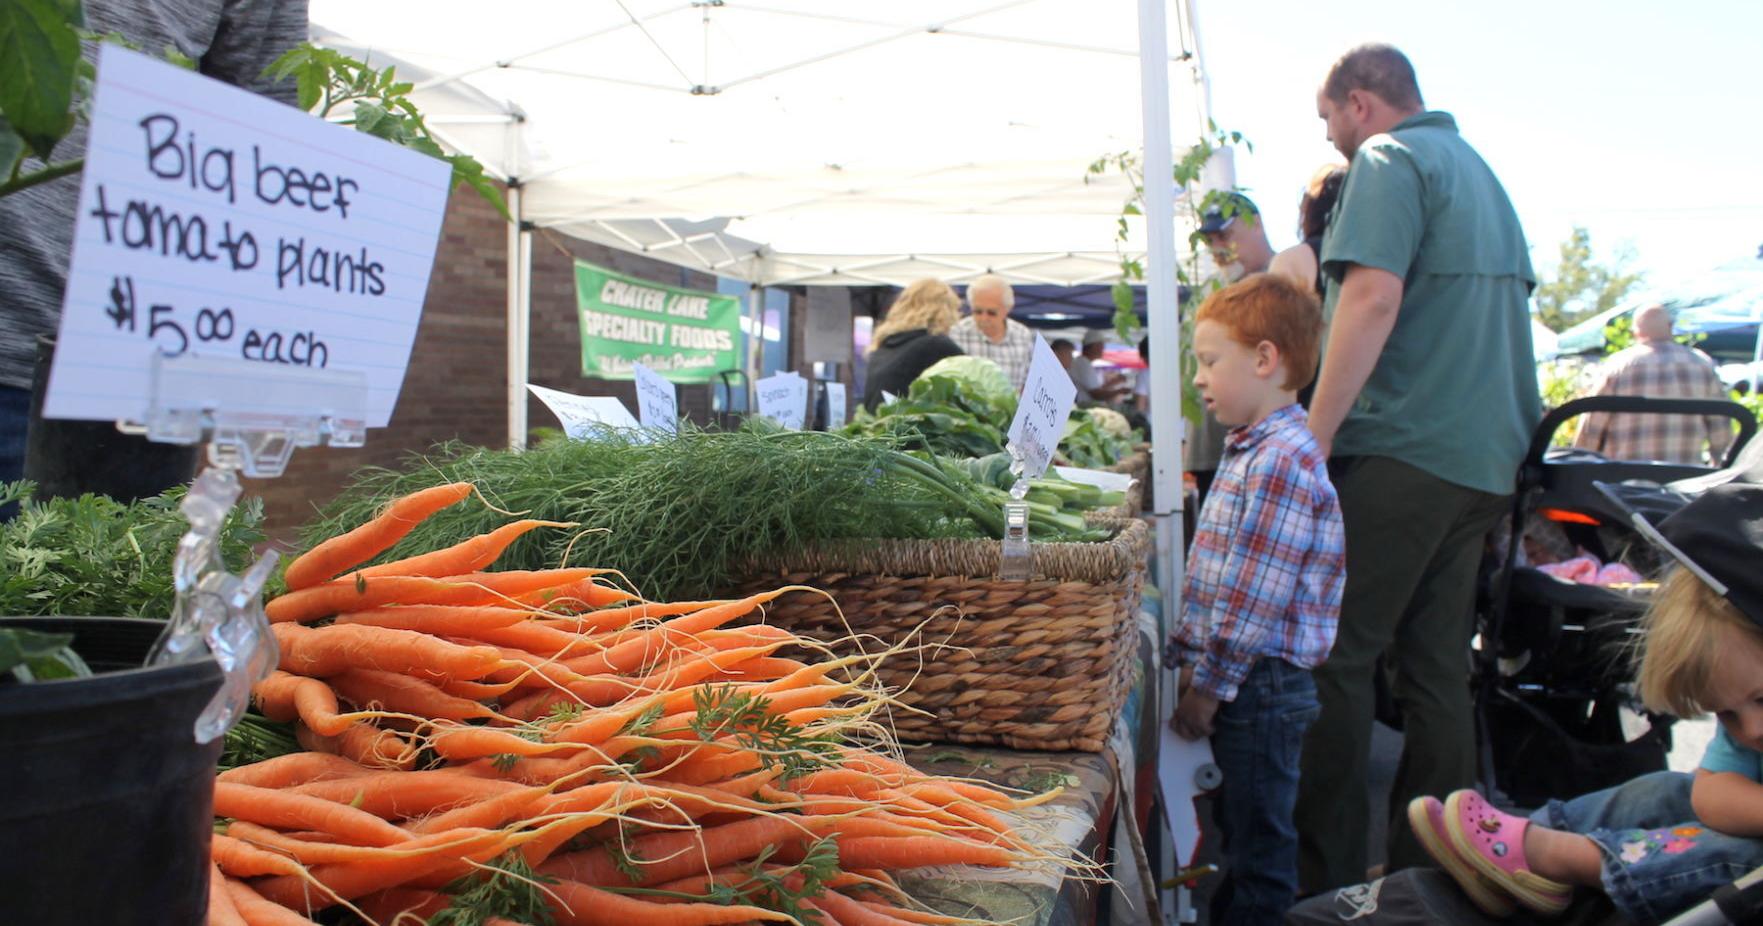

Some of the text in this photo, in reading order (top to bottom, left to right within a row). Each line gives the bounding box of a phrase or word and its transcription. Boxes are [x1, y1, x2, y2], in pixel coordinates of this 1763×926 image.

[140, 114, 235, 204] Big
[91, 185, 385, 295] tomato plants
[602, 281, 710, 318] CRATER LAKE
[243, 329, 328, 369] each
[585, 312, 732, 349] SPECIALTY FOODS
